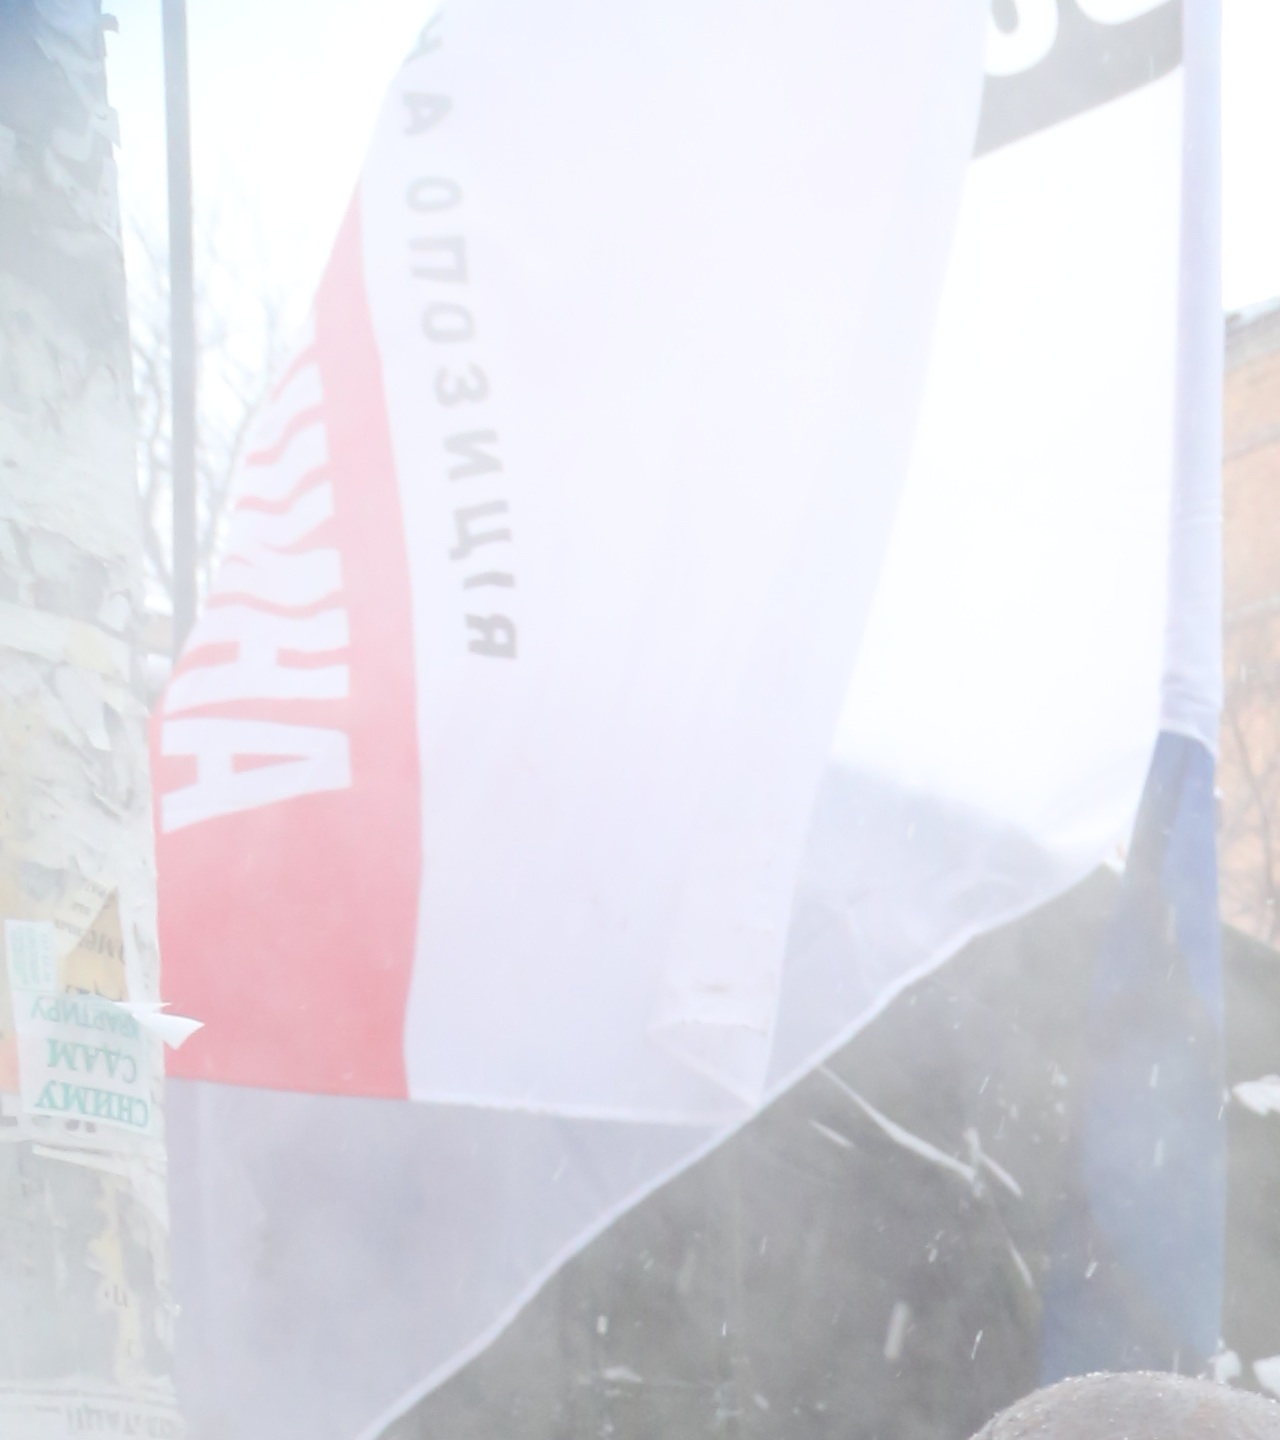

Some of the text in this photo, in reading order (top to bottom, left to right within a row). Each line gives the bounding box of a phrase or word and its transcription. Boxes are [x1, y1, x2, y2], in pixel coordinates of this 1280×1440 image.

[405, 172, 518, 661] ОПОЗИЦІЯ
[47, 1038, 137, 1084] СДАМ
[34, 1080, 149, 1128] СНИМУ
